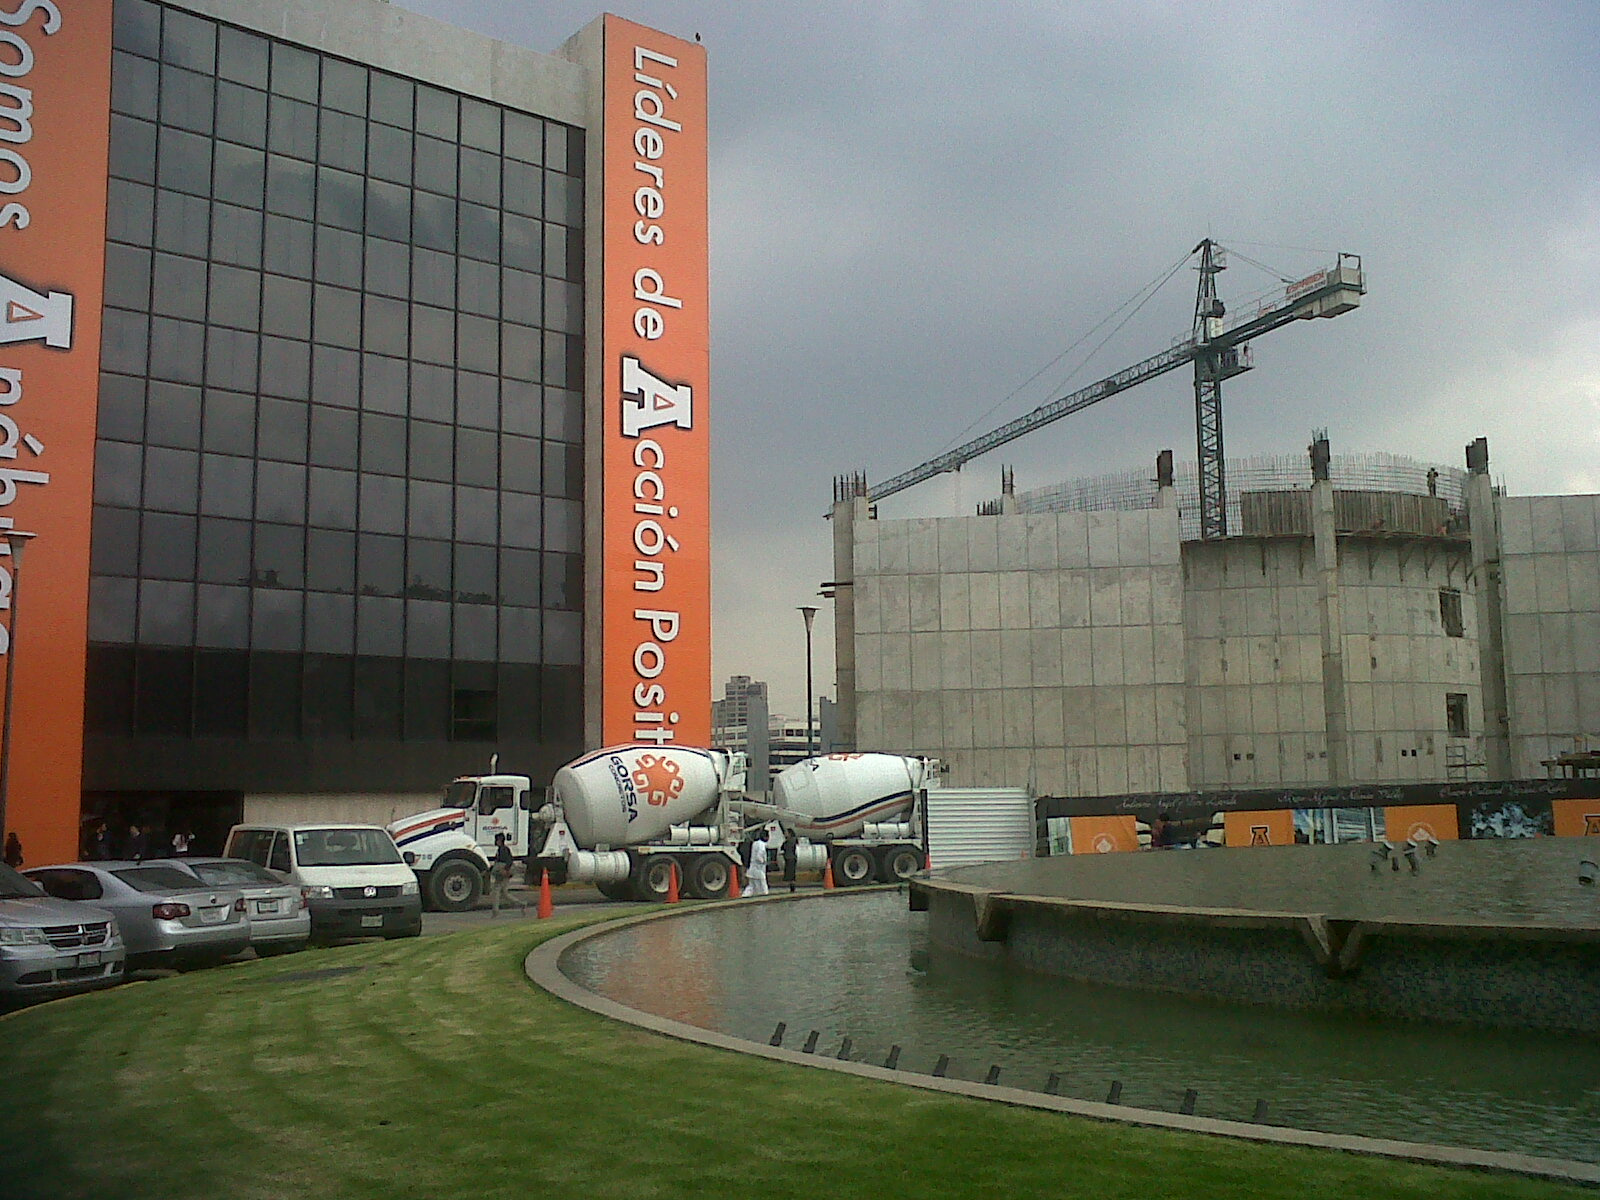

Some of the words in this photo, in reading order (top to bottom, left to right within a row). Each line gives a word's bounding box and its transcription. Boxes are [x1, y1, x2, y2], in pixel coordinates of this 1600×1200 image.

[634, 46, 682, 246] Líderes
[634, 267, 682, 340] de
[622, 356, 692, 591] Acción
[610, 756, 638, 824] GORSA
